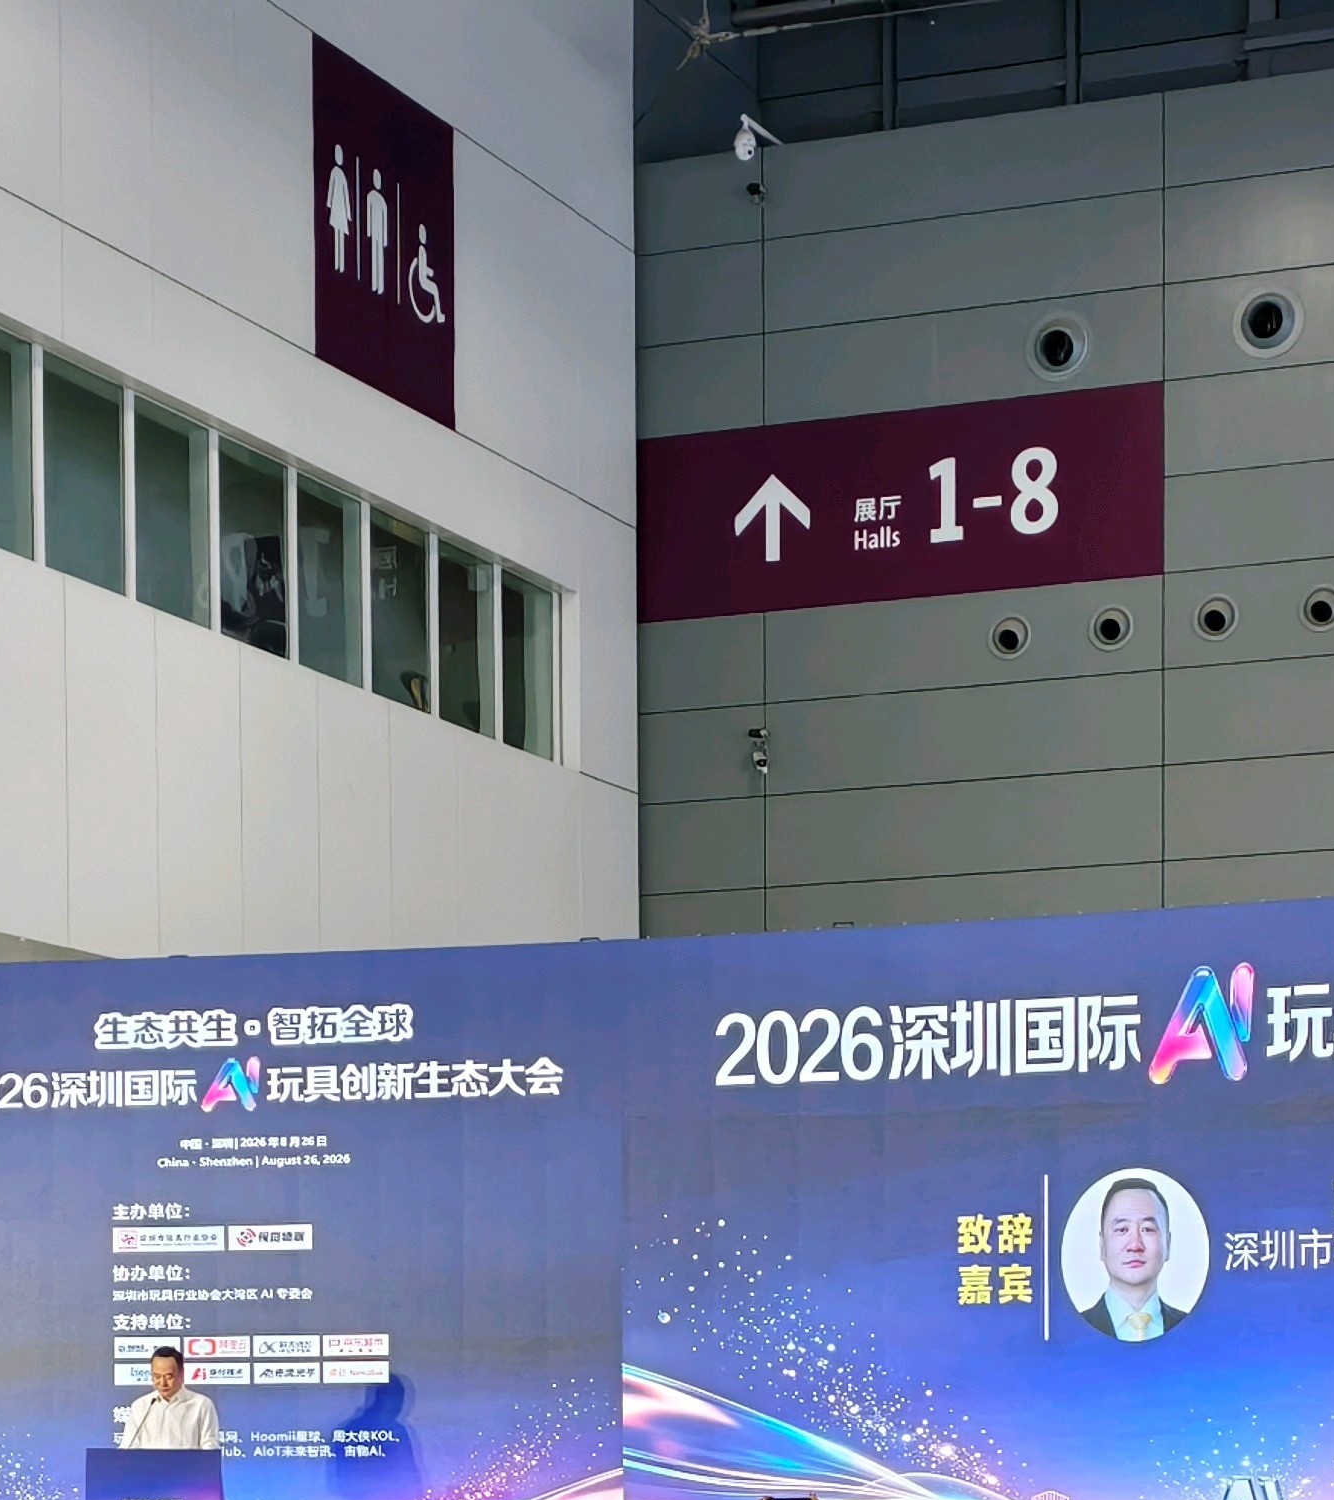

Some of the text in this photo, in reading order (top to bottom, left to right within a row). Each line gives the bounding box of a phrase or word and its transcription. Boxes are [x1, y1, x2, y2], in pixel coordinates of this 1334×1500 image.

[854, 495, 902, 523] 展厅
[929, 446, 1059, 543] 1-8
[854, 526, 901, 551] Halls
[157, 1156, 190, 1168] China
[199, 1155, 253, 1168] Shenzhen
[261, 1155, 302, 1168] August
[322, 1153, 351, 1165] 2026
[957, 1213, 1033, 1254] 致辞
[957, 1264, 1033, 1305] 嘉宾
